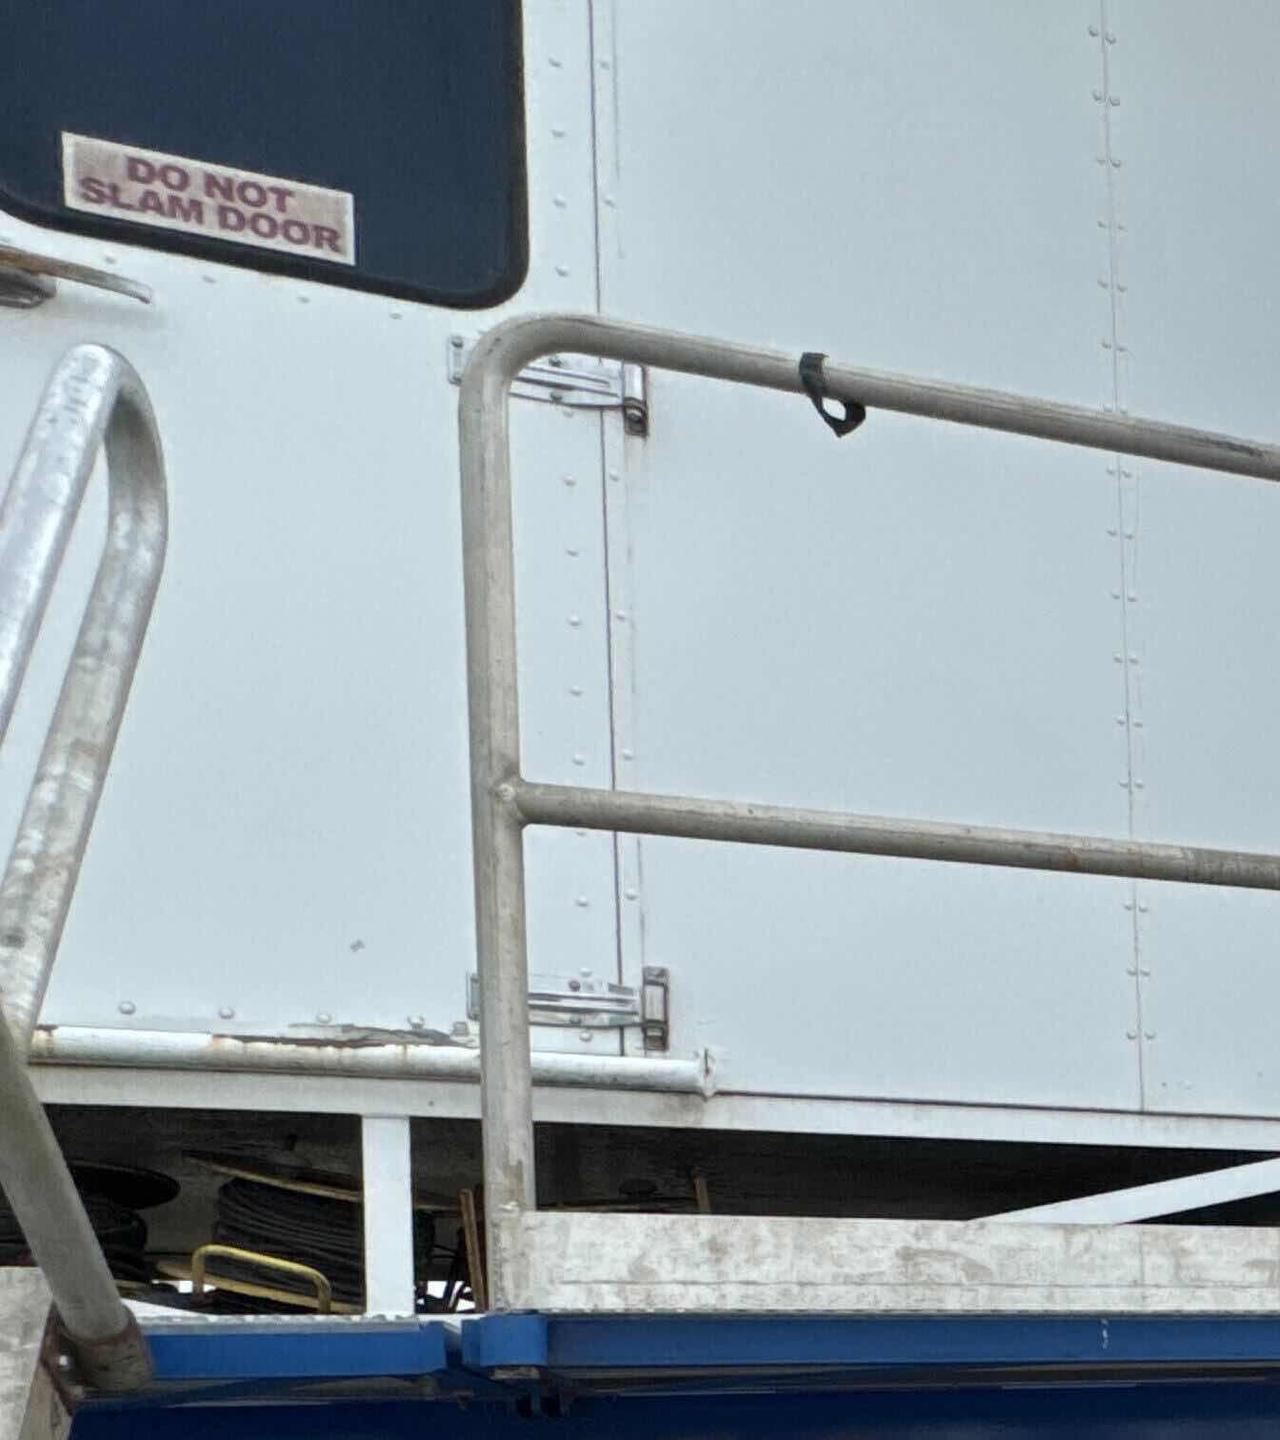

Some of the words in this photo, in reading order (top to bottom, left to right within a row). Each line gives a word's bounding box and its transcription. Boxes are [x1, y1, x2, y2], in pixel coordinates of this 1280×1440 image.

[79, 177, 203, 225] SLAM
[218, 205, 341, 253] DOOR
[126, 156, 189, 191] DO
[204, 172, 295, 213] NOT
